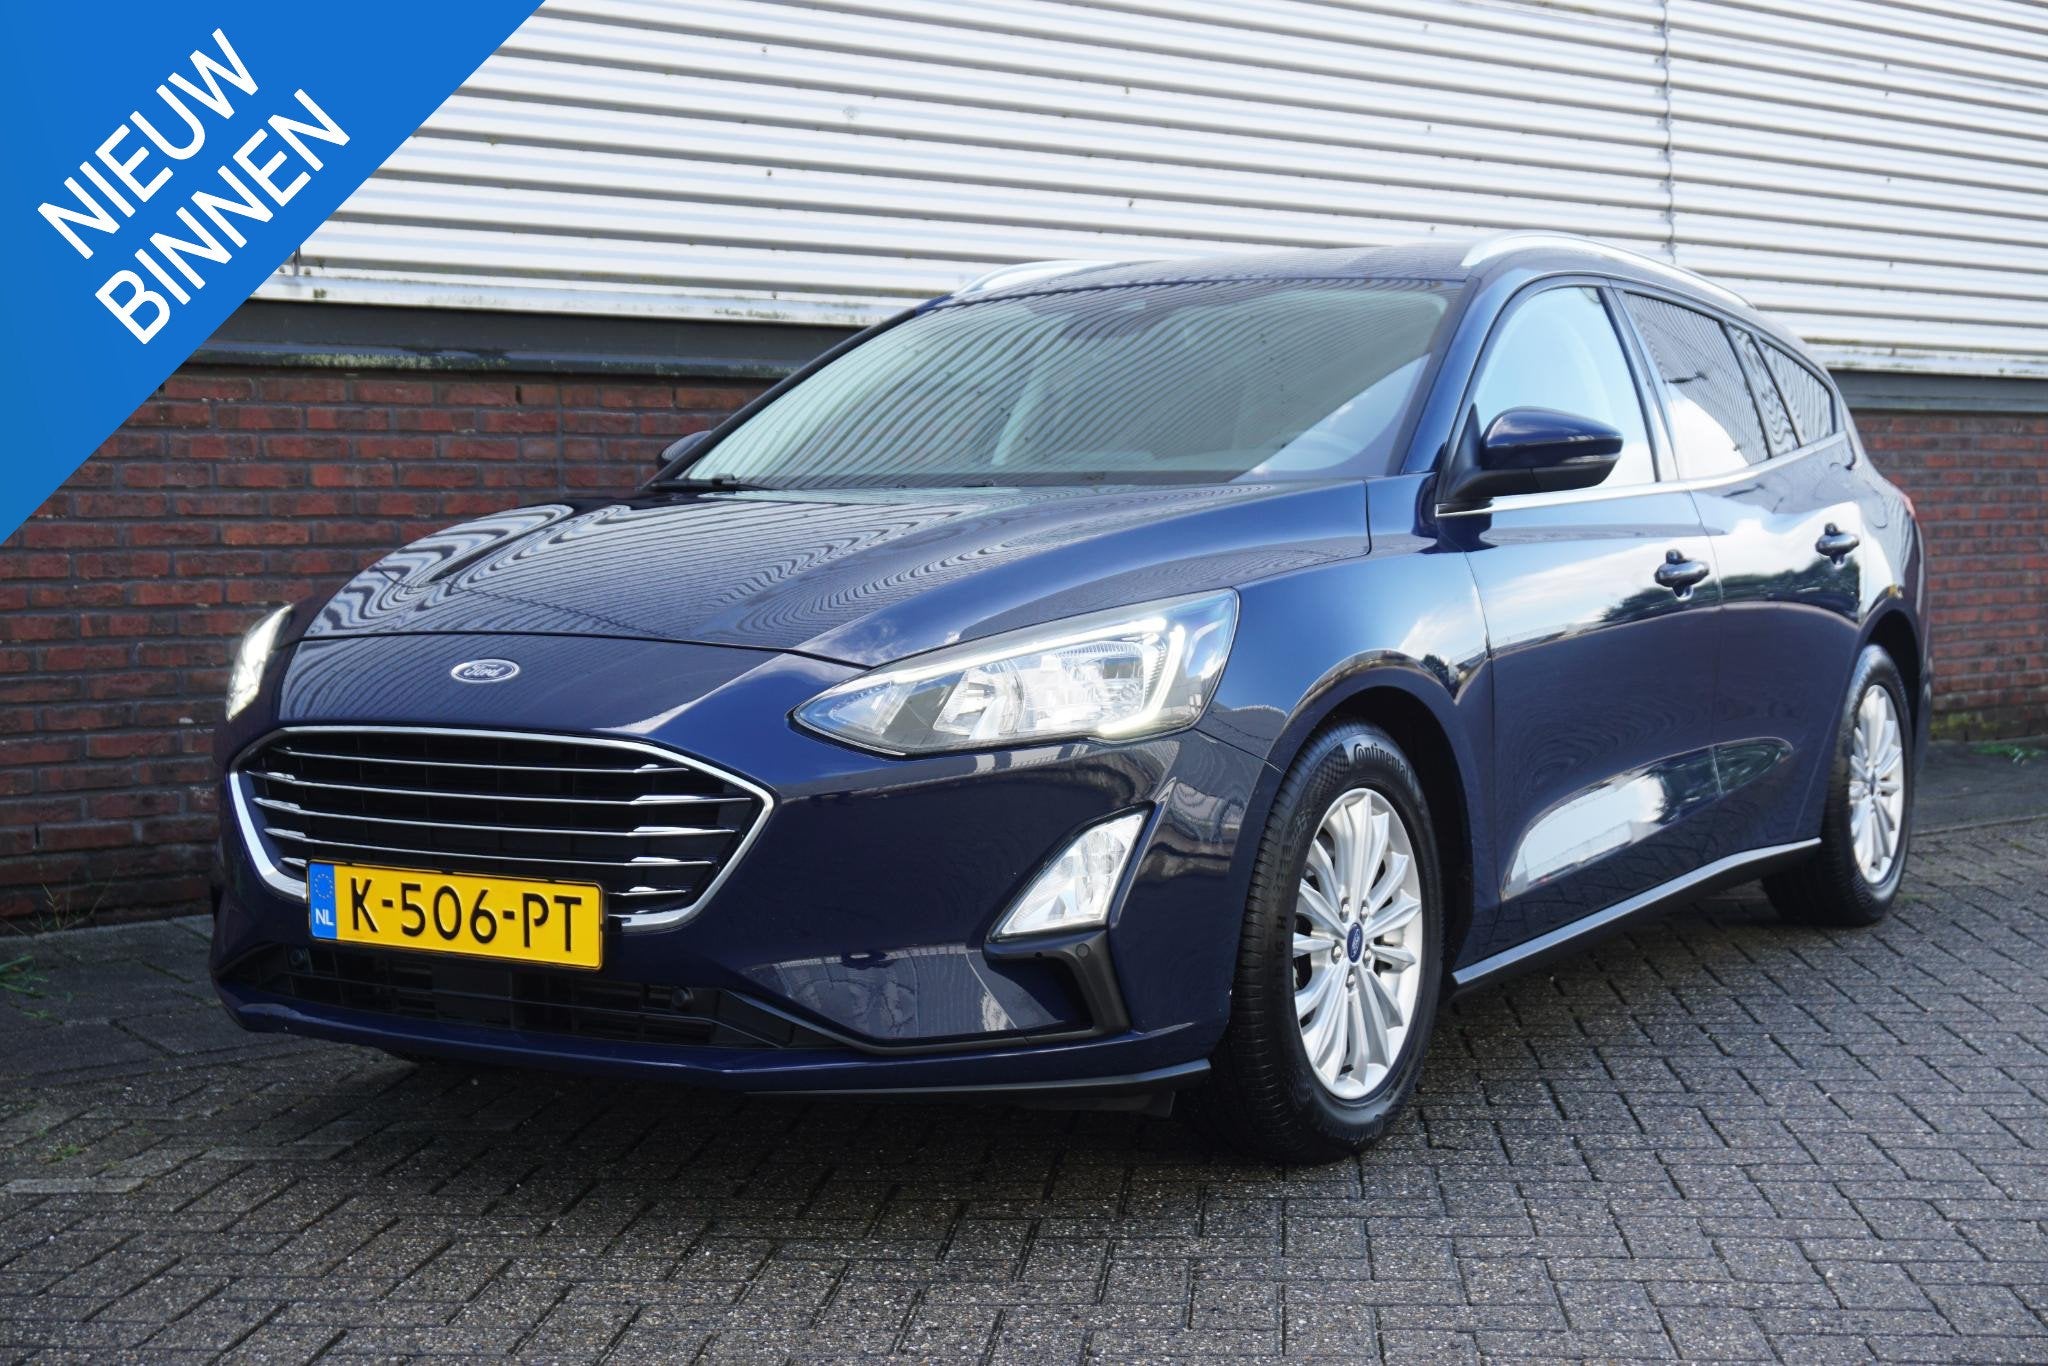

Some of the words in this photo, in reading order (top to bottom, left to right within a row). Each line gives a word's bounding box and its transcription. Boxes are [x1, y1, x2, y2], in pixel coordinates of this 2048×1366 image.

[1353, 742, 1410, 783] Continental
[315, 908, 334, 926] NL
[350, 877, 583, 952] K-506-PT
